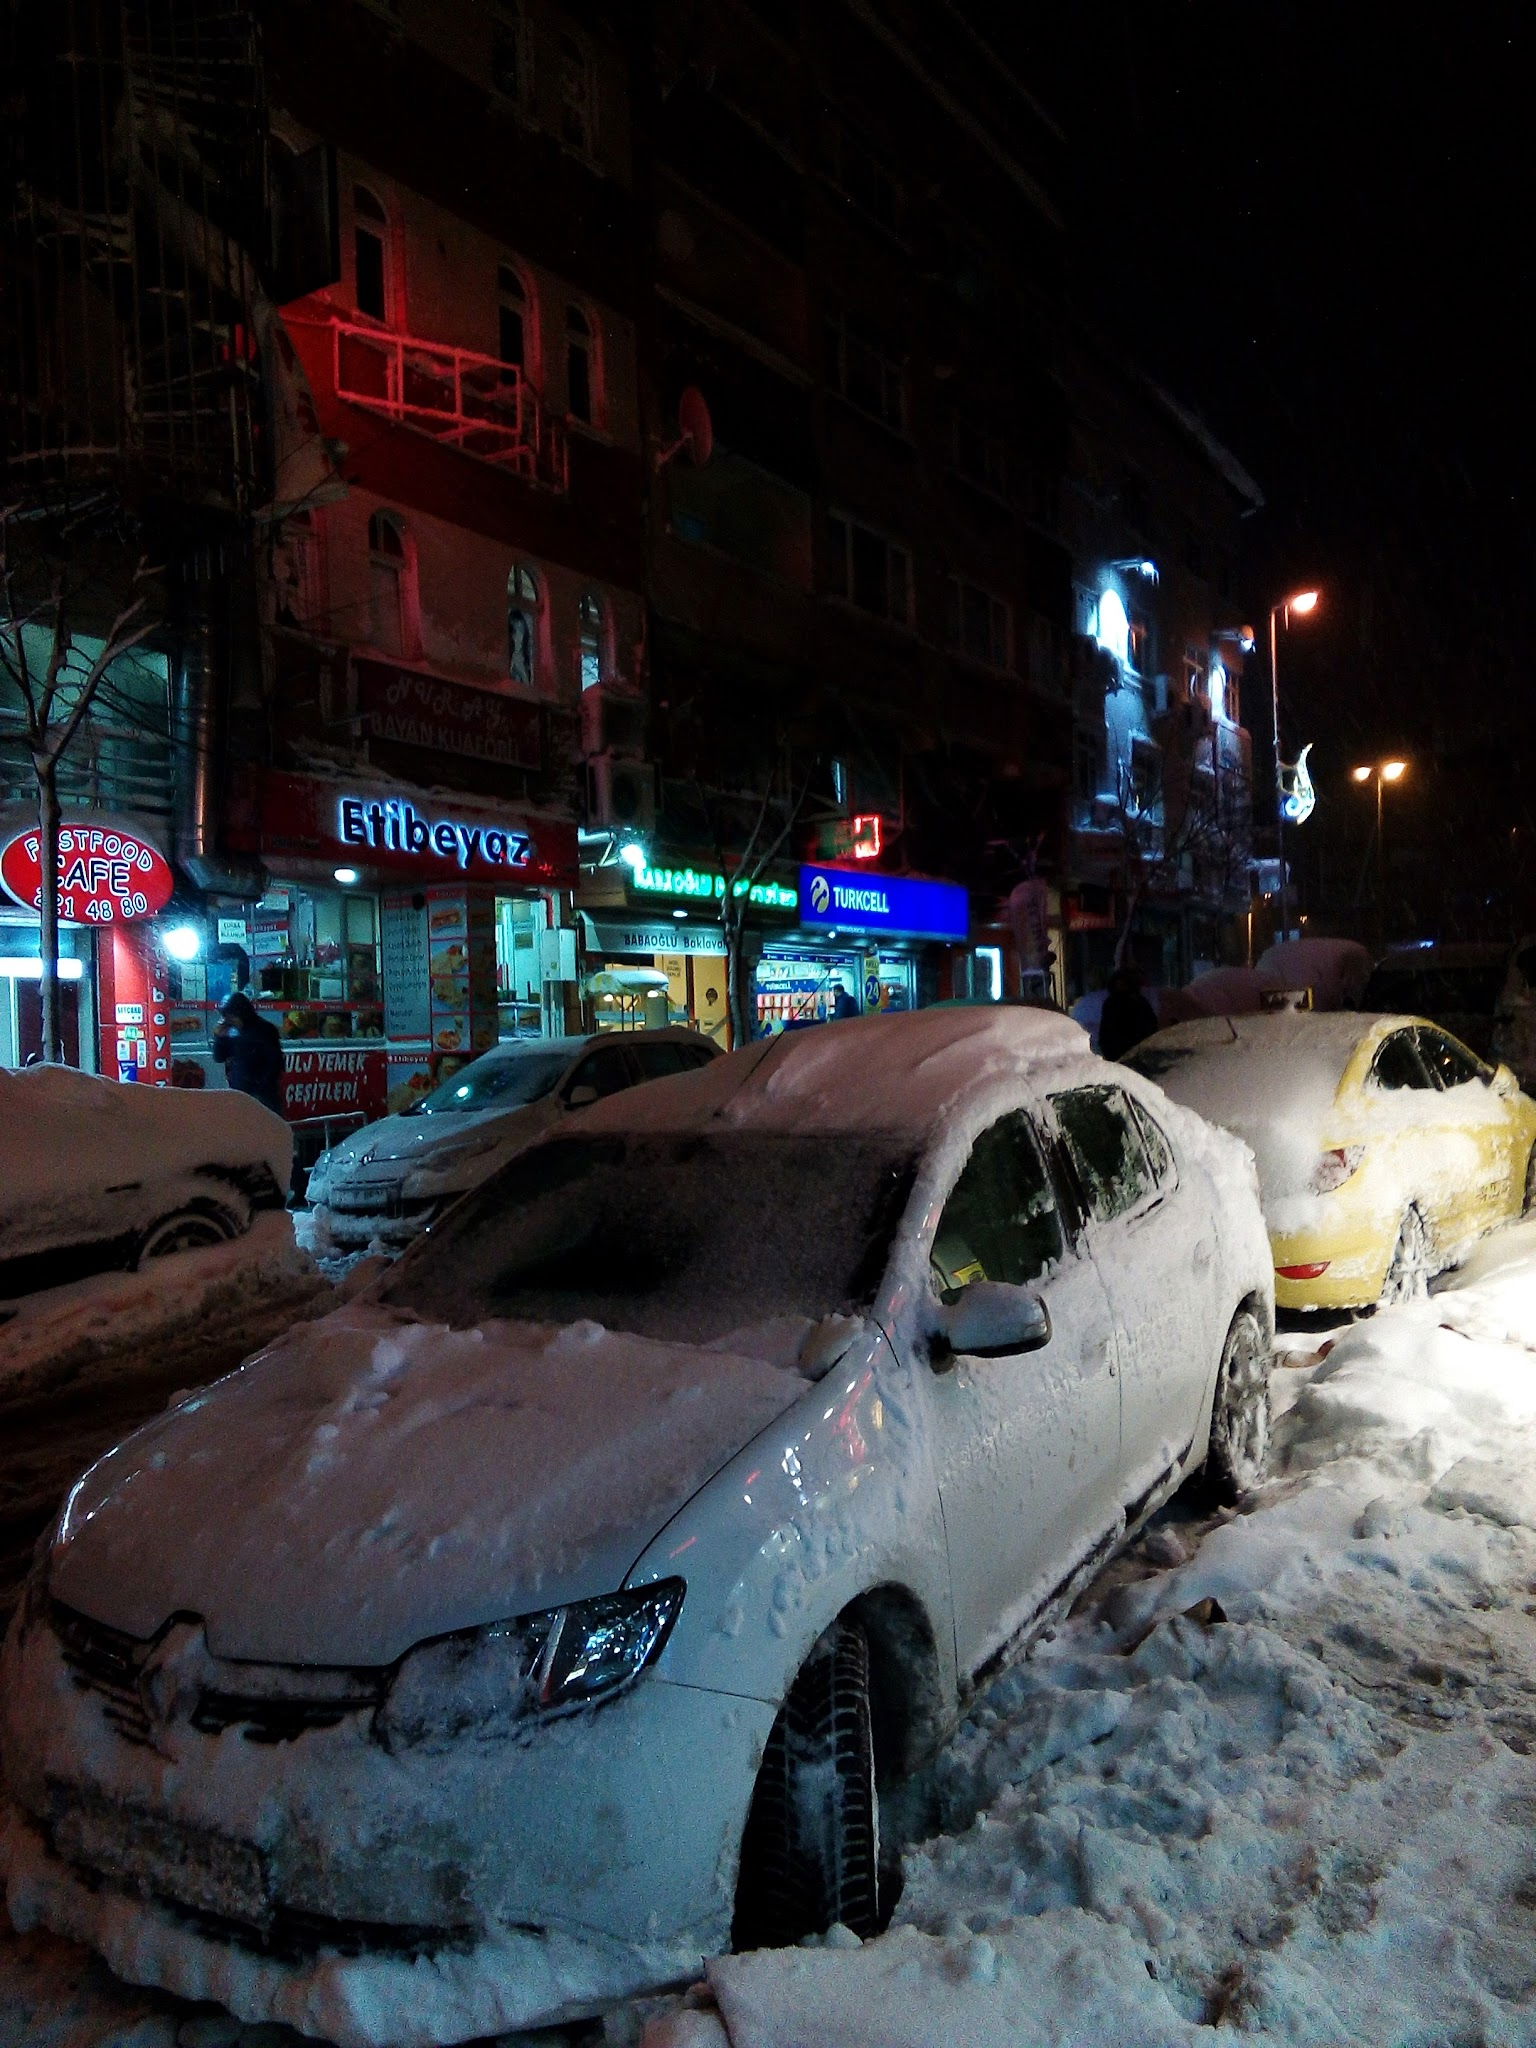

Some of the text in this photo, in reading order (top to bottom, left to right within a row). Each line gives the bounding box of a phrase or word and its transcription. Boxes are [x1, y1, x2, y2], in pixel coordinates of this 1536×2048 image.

[24, 829, 154, 872] FSTFOOD
[339, 798, 531, 869] Etibeyaz
[86, 899, 114, 922] 48
[120, 892, 148, 919] 80
[833, 886, 889, 913] TURKCELL
